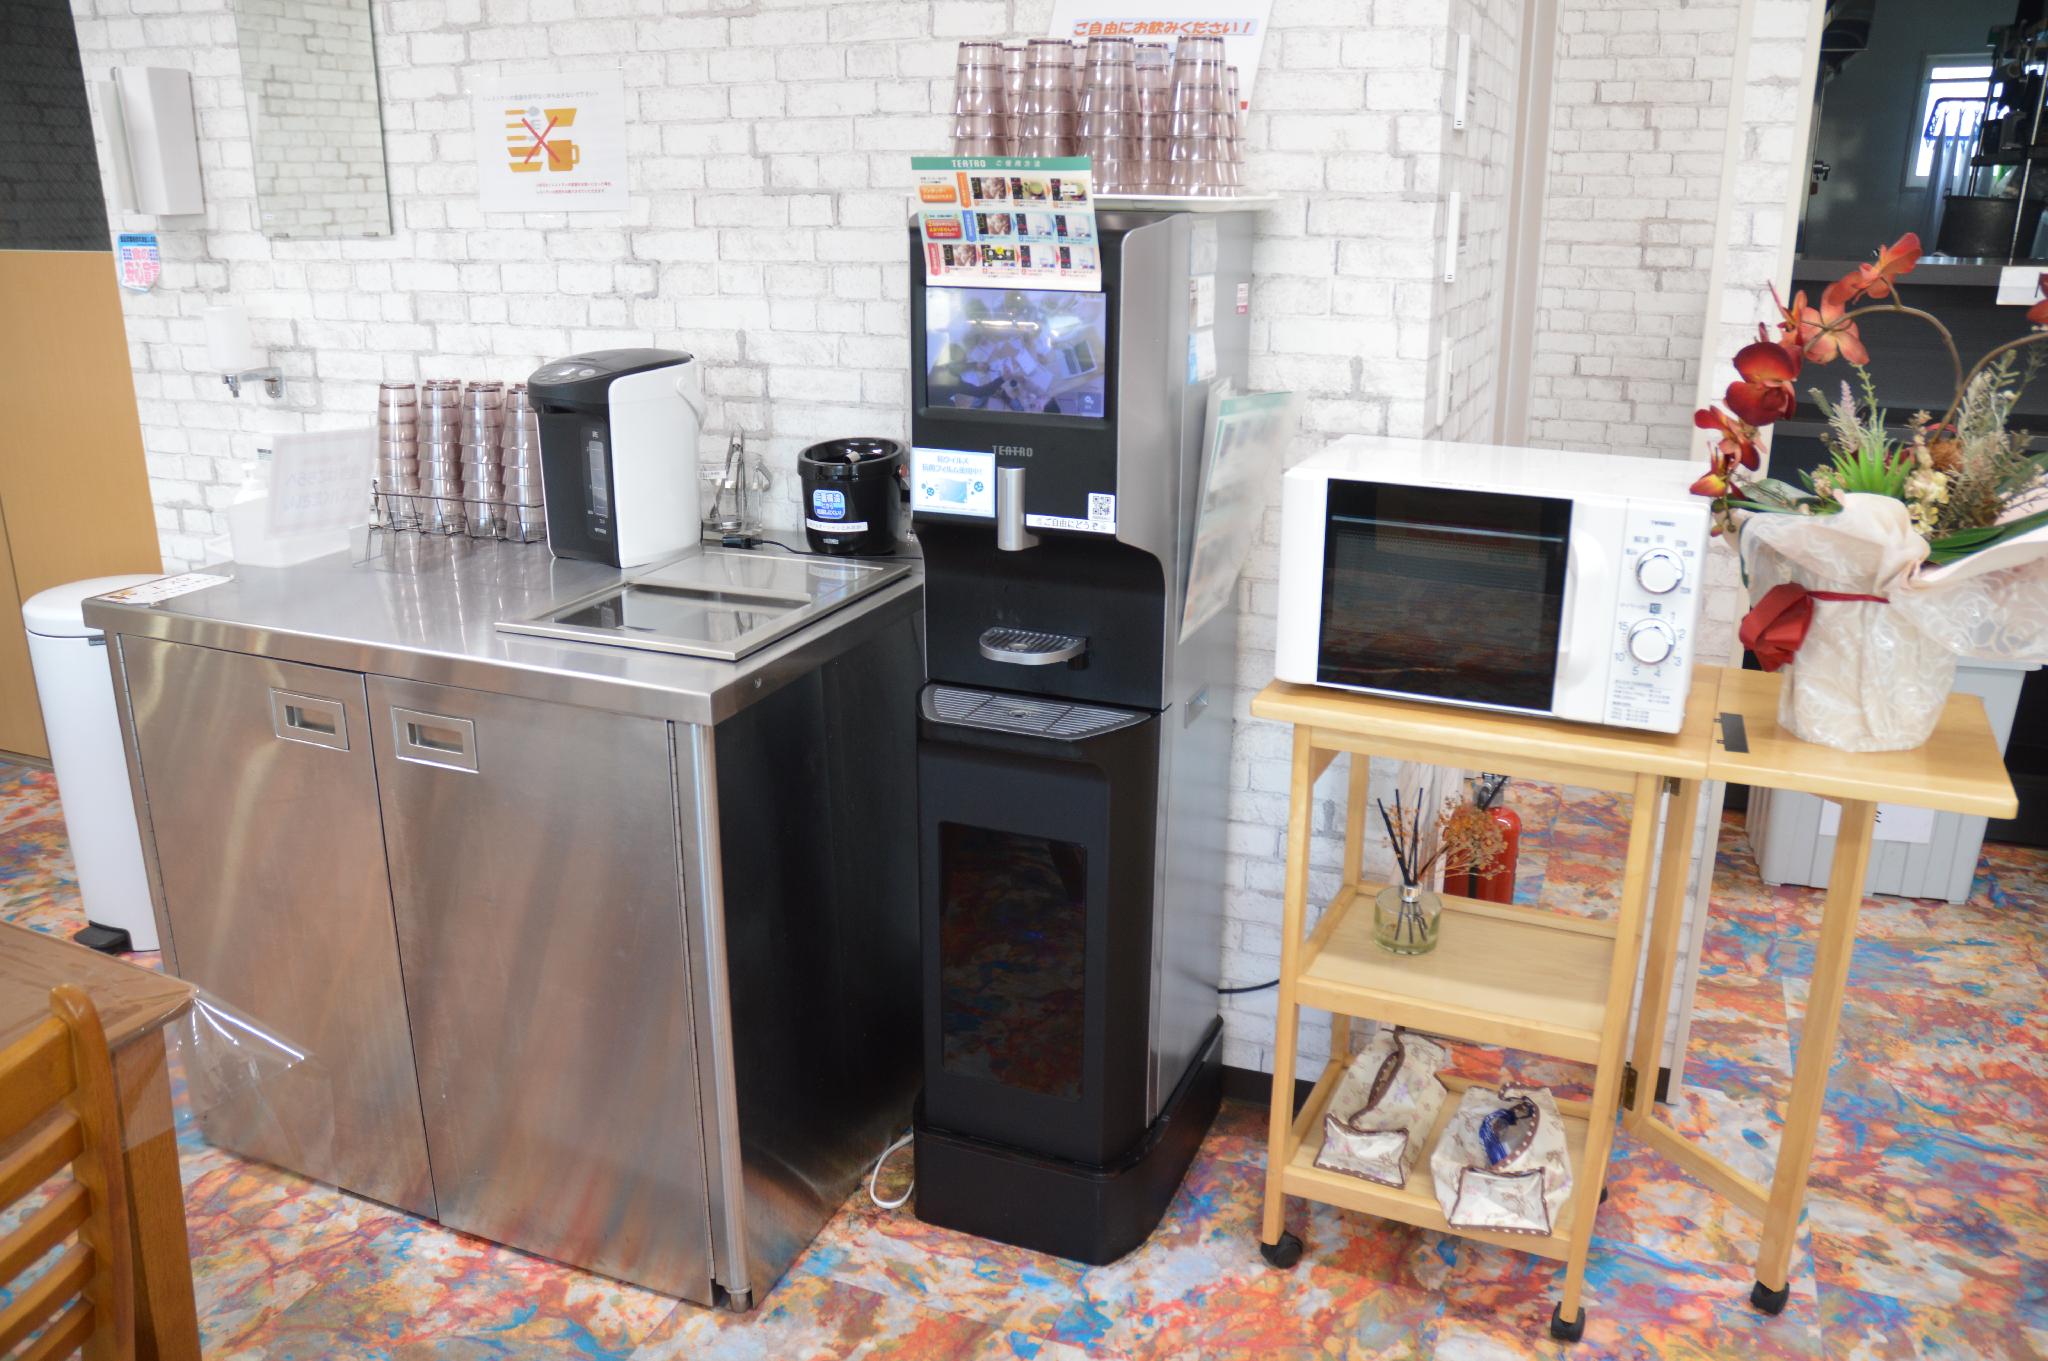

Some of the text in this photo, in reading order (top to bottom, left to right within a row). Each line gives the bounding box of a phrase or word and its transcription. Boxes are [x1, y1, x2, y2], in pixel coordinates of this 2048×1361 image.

[1073, 20, 1251, 36] ご自由にお飲みください！
[951, 159, 986, 168] TEATRO
[992, 445, 1033, 457] TEATRO
